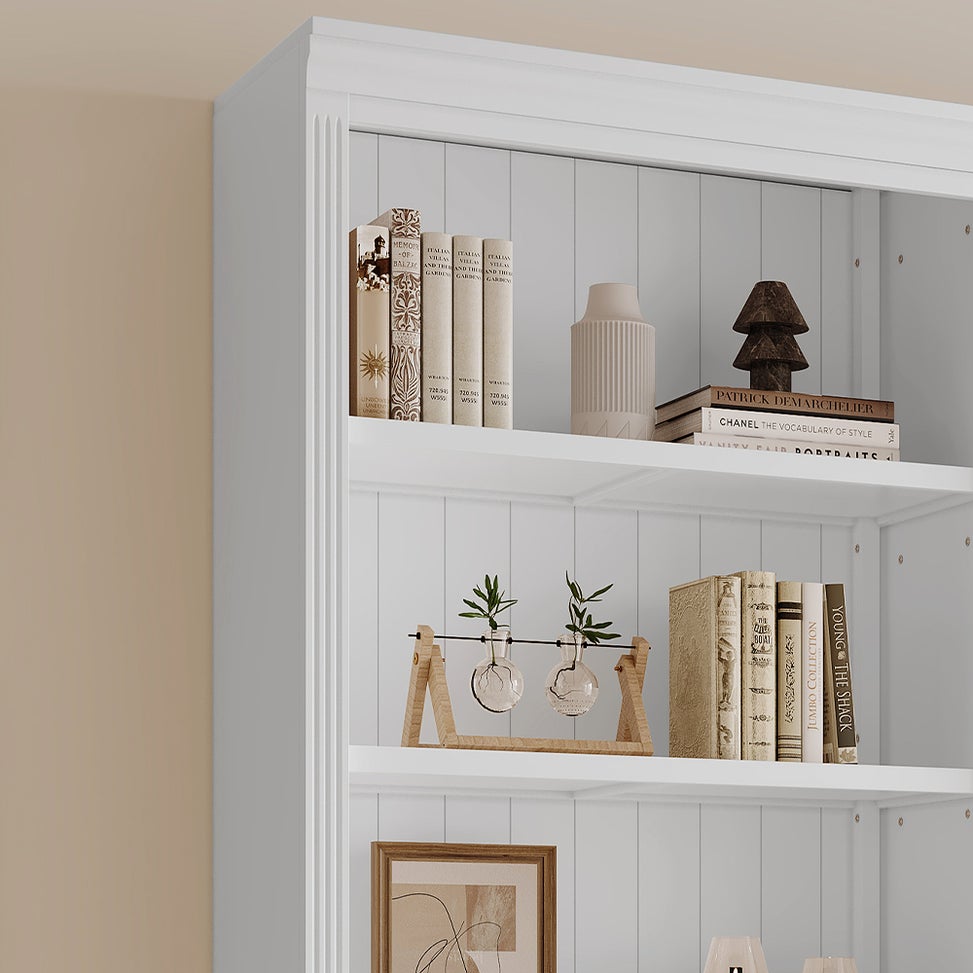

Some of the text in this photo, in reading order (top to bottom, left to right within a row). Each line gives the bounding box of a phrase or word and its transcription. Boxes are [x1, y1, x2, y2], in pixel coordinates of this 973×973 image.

[716, 390, 770, 406] PATRICK
[774, 395, 875, 414] DEMARCHELIER
[719, 418, 759, 429] CHANEL
[761, 421, 778, 431] THE
[778, 422, 834, 435] VOCABULARY
[835, 428, 848, 436] OF
[848, 428, 872, 438] STYLE
[806, 621, 818, 731] JUMBO COLLECTION
[832, 605, 852, 732] YOUNG THE SHACK
